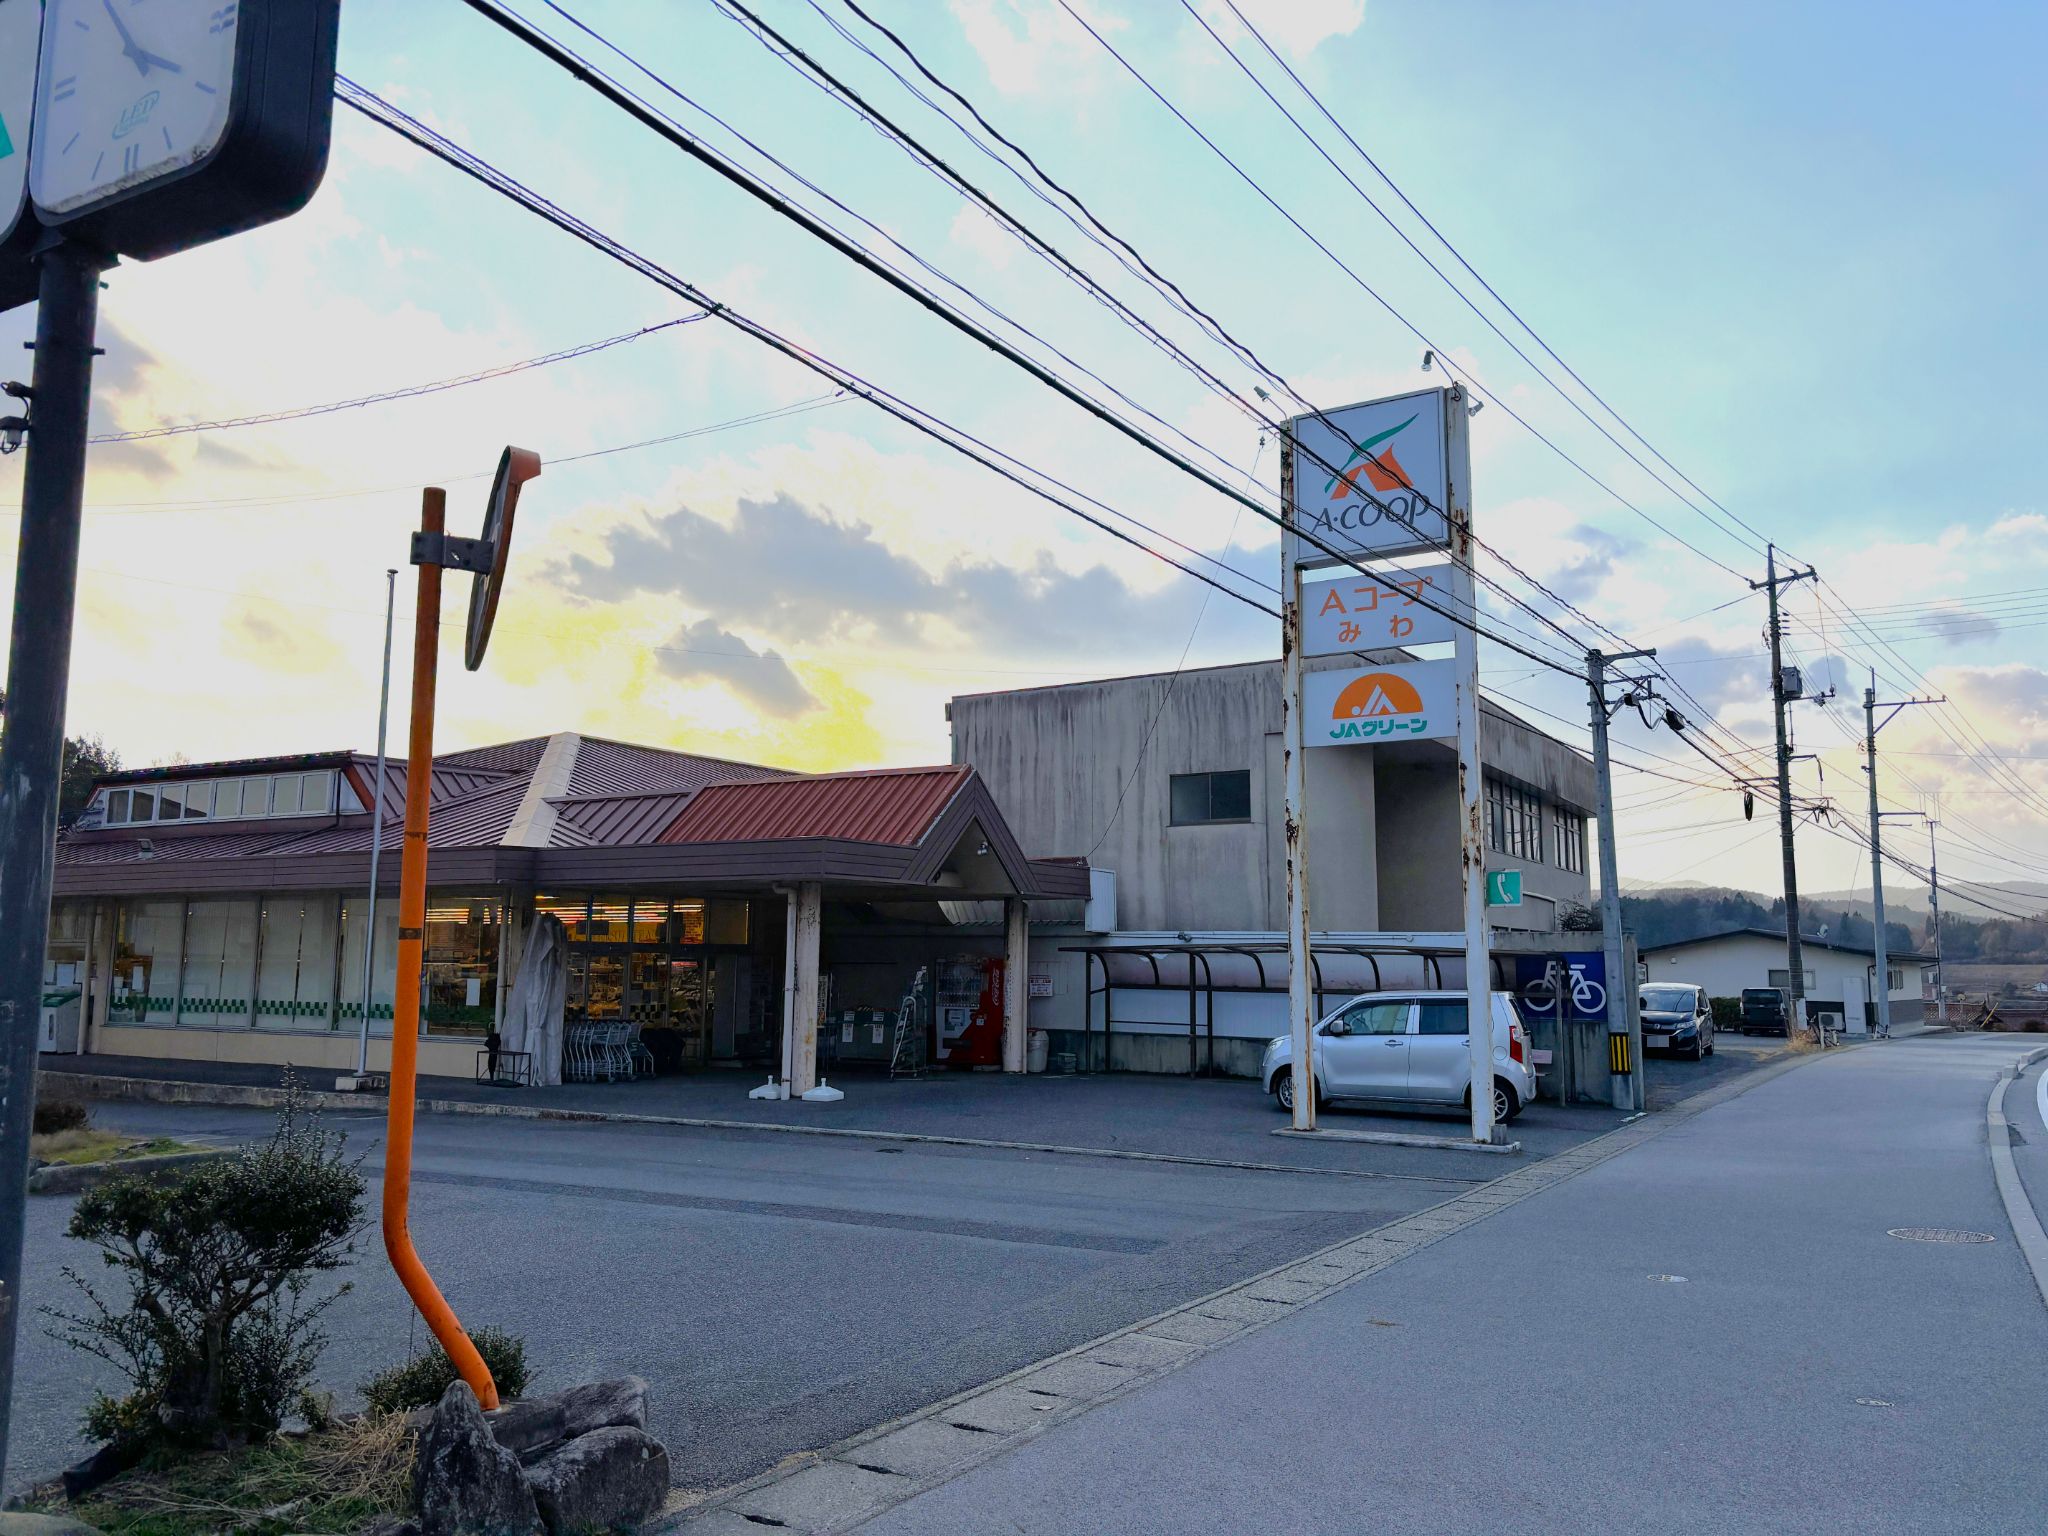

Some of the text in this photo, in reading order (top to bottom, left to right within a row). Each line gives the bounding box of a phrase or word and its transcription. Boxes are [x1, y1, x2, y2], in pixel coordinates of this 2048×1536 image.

[1320, 577, 1433, 616] Aコープ
[1329, 719, 1428, 739] JAグリーン
